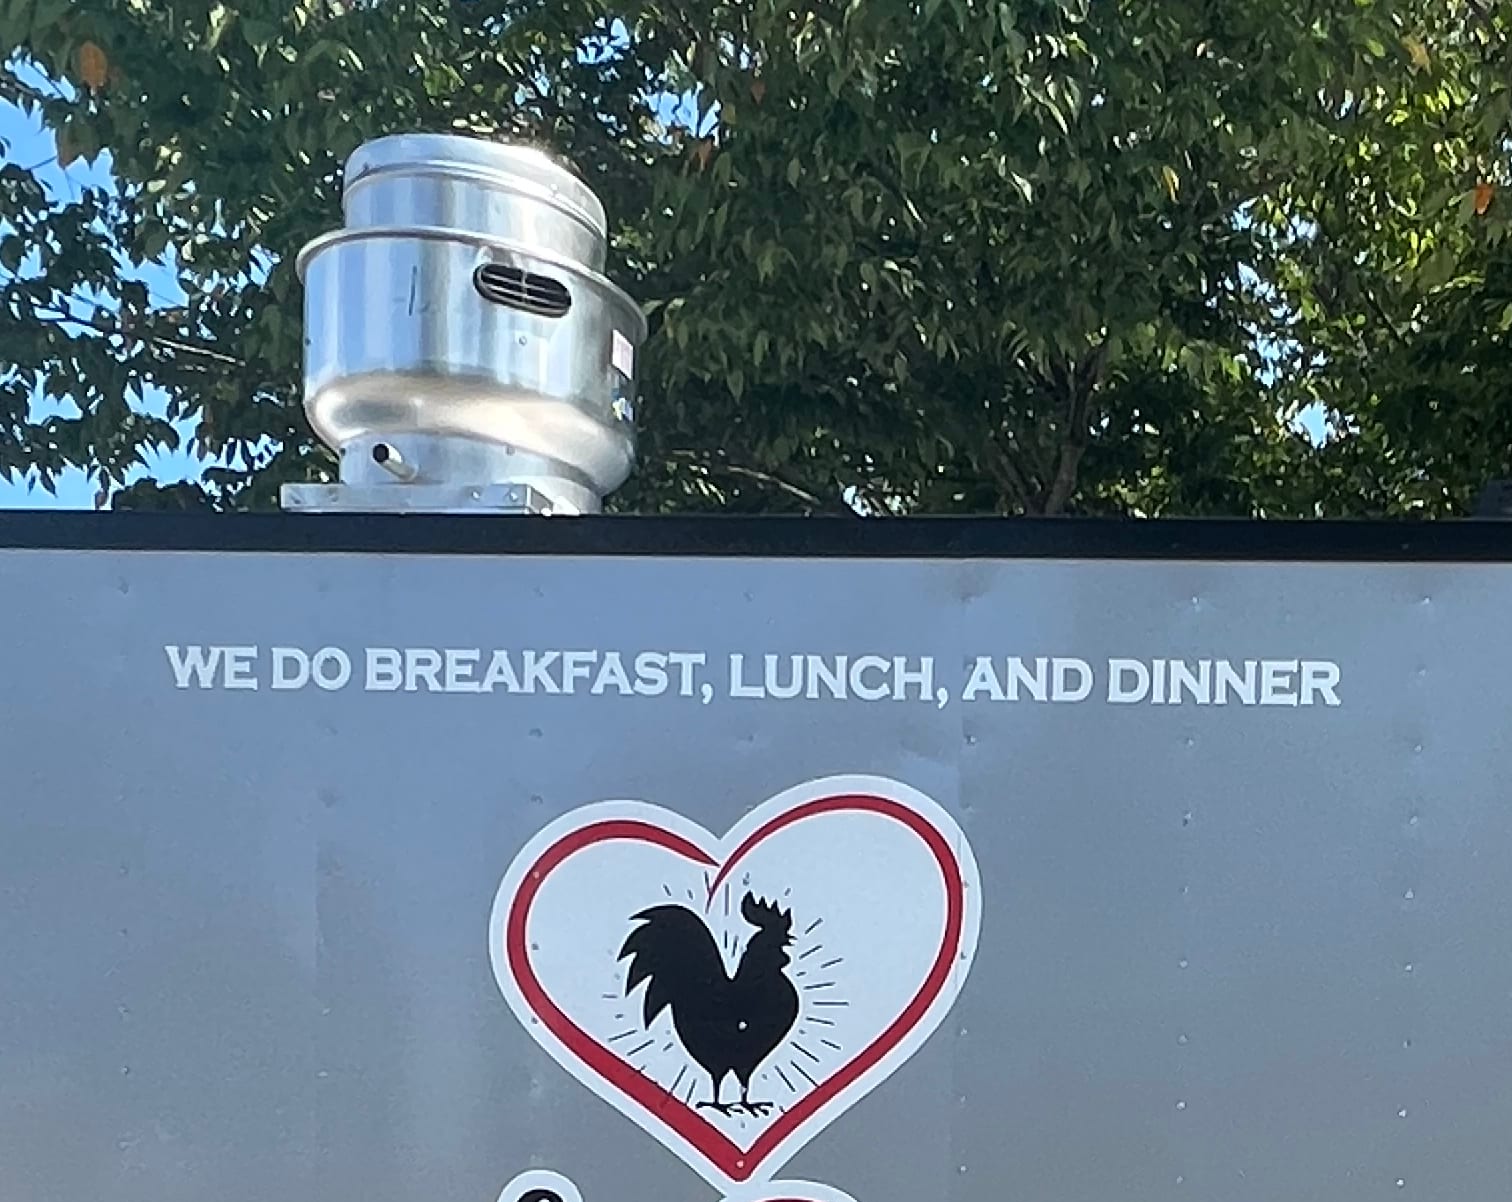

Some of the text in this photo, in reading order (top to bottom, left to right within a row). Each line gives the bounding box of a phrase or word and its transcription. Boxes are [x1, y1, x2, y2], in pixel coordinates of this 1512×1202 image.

[165, 645, 1342, 710] WE DO BREAKFAST, LUNCH, AND DINNER
